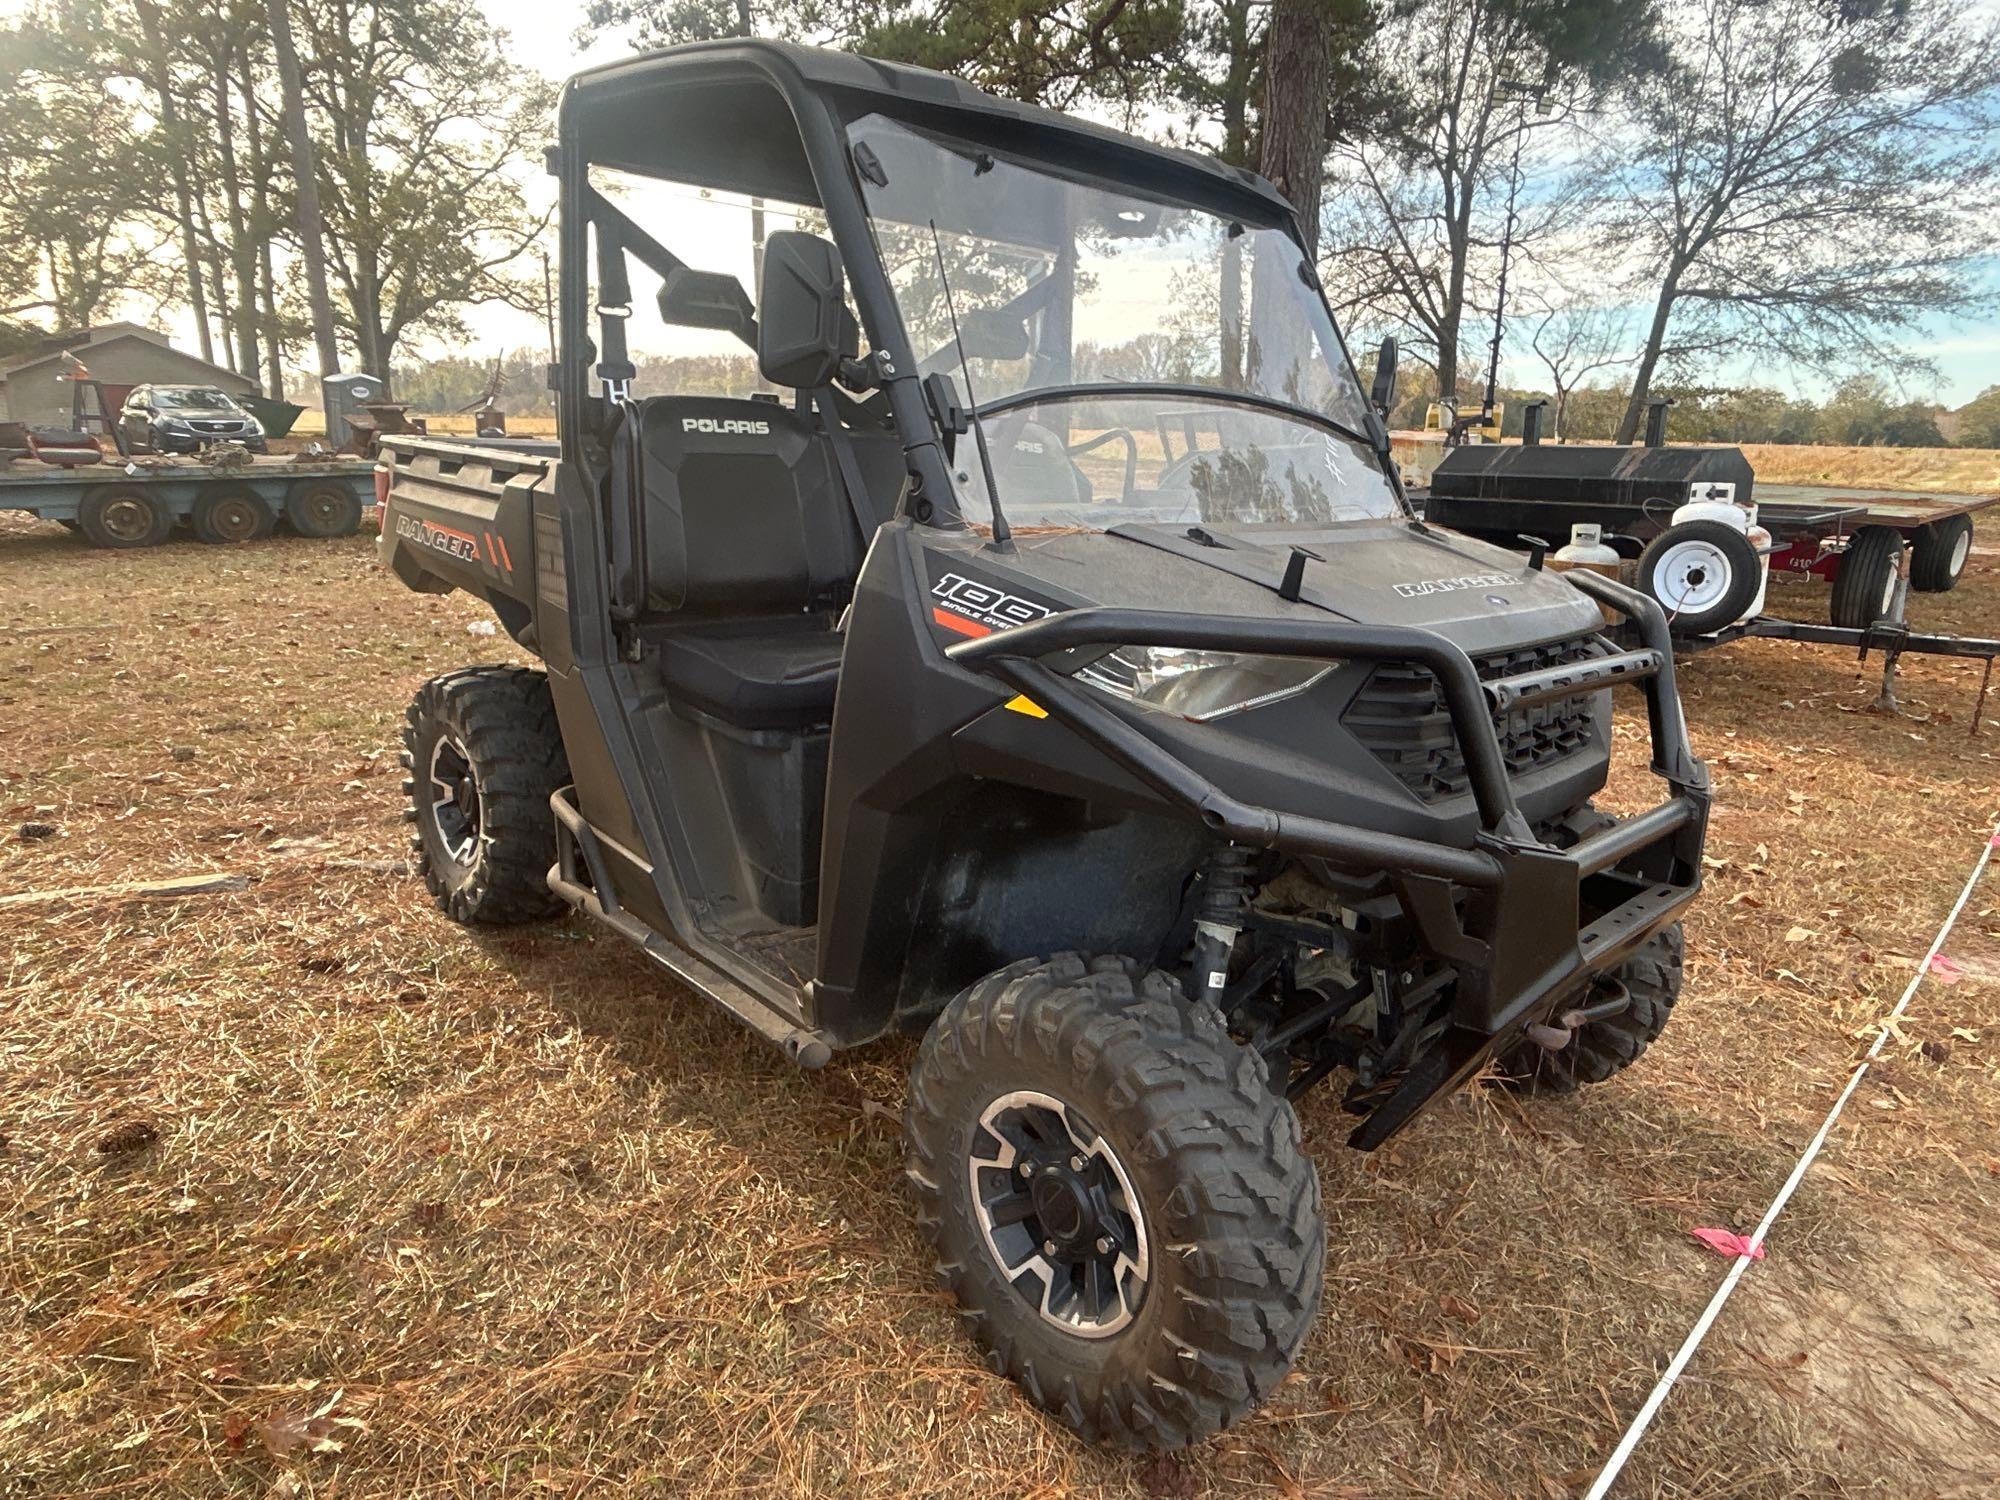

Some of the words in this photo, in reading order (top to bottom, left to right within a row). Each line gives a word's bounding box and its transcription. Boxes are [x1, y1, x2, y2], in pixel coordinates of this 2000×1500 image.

[681, 418, 770, 434] POLARIS
[395, 515, 475, 562] RANGER
[1392, 576, 1525, 598] RANGER
[931, 573, 1059, 625] 100
[983, 616, 1014, 630] OVER
